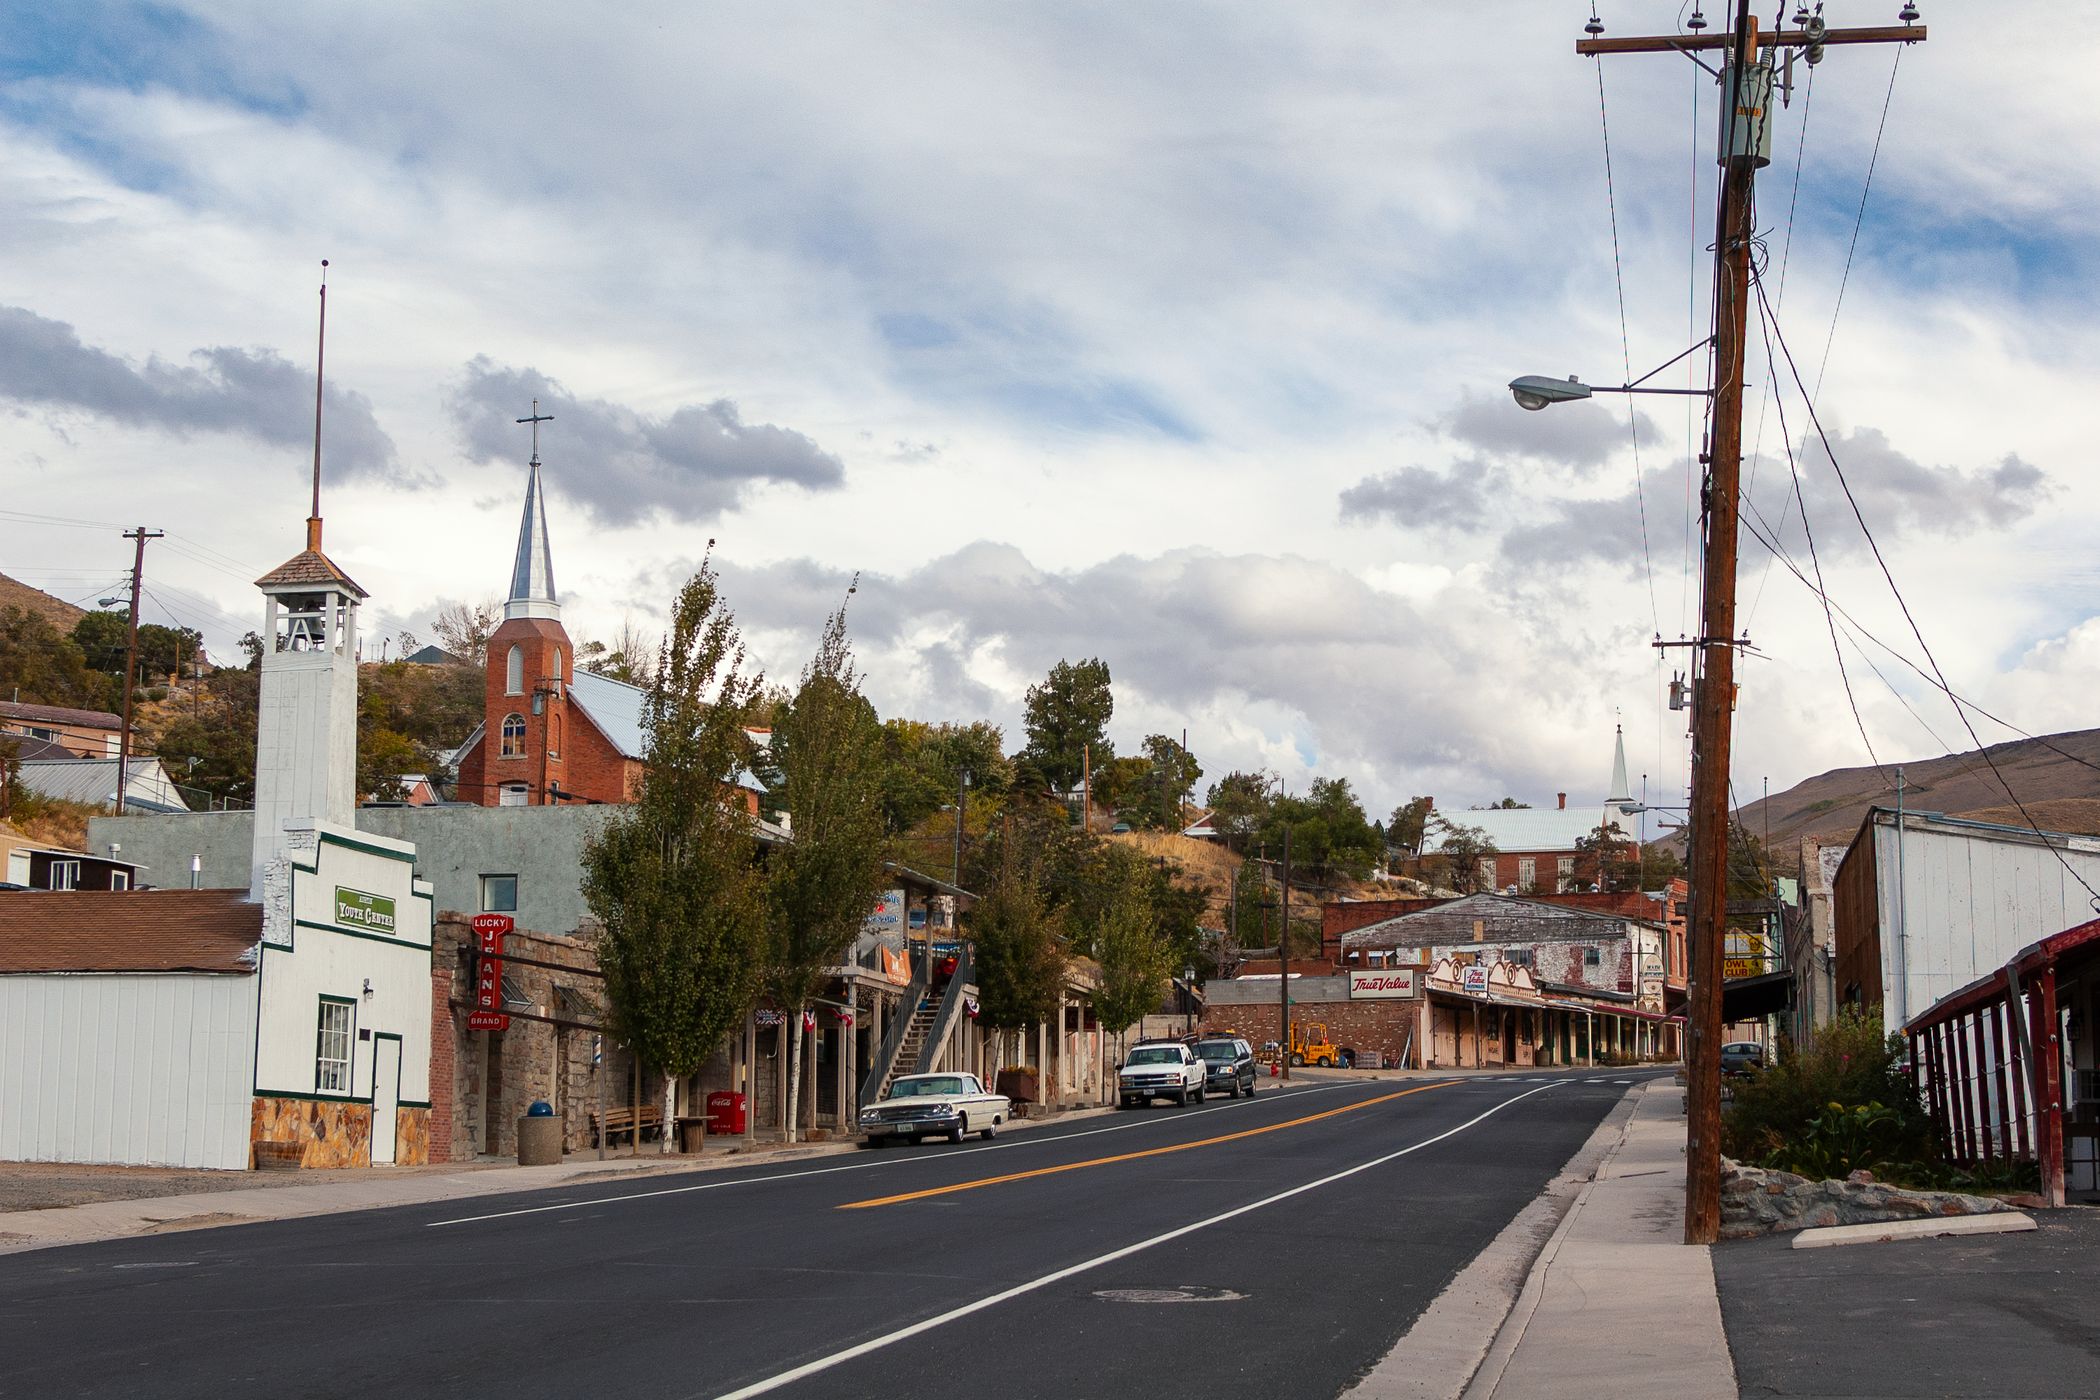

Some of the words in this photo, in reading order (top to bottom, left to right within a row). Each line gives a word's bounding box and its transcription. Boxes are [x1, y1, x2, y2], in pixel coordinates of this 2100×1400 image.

[339, 902, 364, 920] YOUTH
[365, 908, 394, 927] CENTER
[474, 919, 506, 927] LUCKY
[482, 930, 494, 1006] JEANS
[1726, 960, 1747, 968] OWL
[1725, 968, 1748, 977] CLUB
[1352, 978, 1378, 991] True
[1373, 976, 1410, 991] Value
[471, 1017, 500, 1025] BRAND
